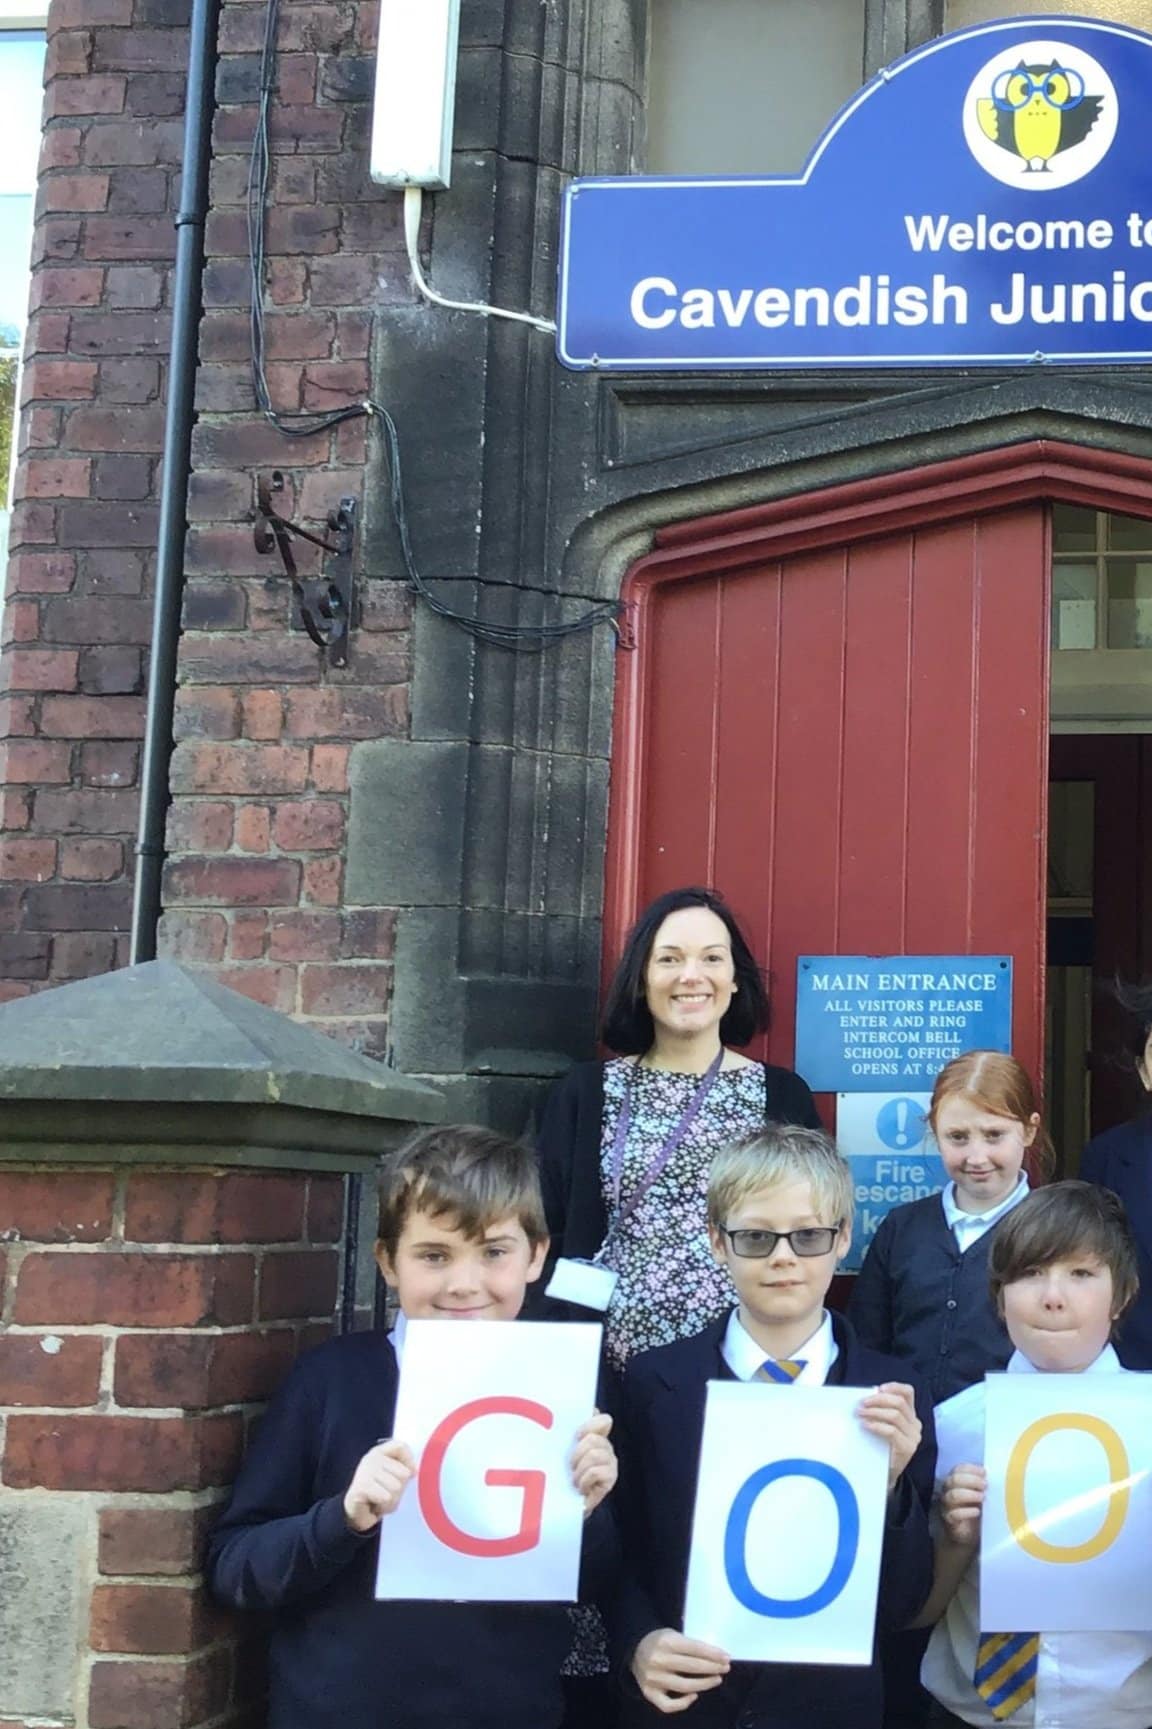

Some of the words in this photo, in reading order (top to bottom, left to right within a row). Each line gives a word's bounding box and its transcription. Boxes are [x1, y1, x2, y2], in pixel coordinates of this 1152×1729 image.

[904, 215, 1114, 252] Welcome
[629, 274, 968, 329] Cavendish
[812, 974, 870, 991] MAIN
[878, 974, 997, 991] ENTRANCE
[824, 1000, 852, 1012] ALL
[858, 1000, 924, 1012] VISITORS
[929, 1000, 983, 1012] PLEASE
[840, 1016, 888, 1028] ENTER
[894, 1016, 925, 1028] AND
[930, 1016, 967, 1028] RING
[843, 1032, 920, 1044] INTERCOM
[925, 1032, 961, 1044] BELL
[844, 1047, 903, 1059] SCHOOL
[907, 1047, 960, 1059] OFFICE
[852, 1063, 898, 1075] OPENS
[903, 1063, 922, 1075] AT
[876, 1160, 925, 1183] Fire
